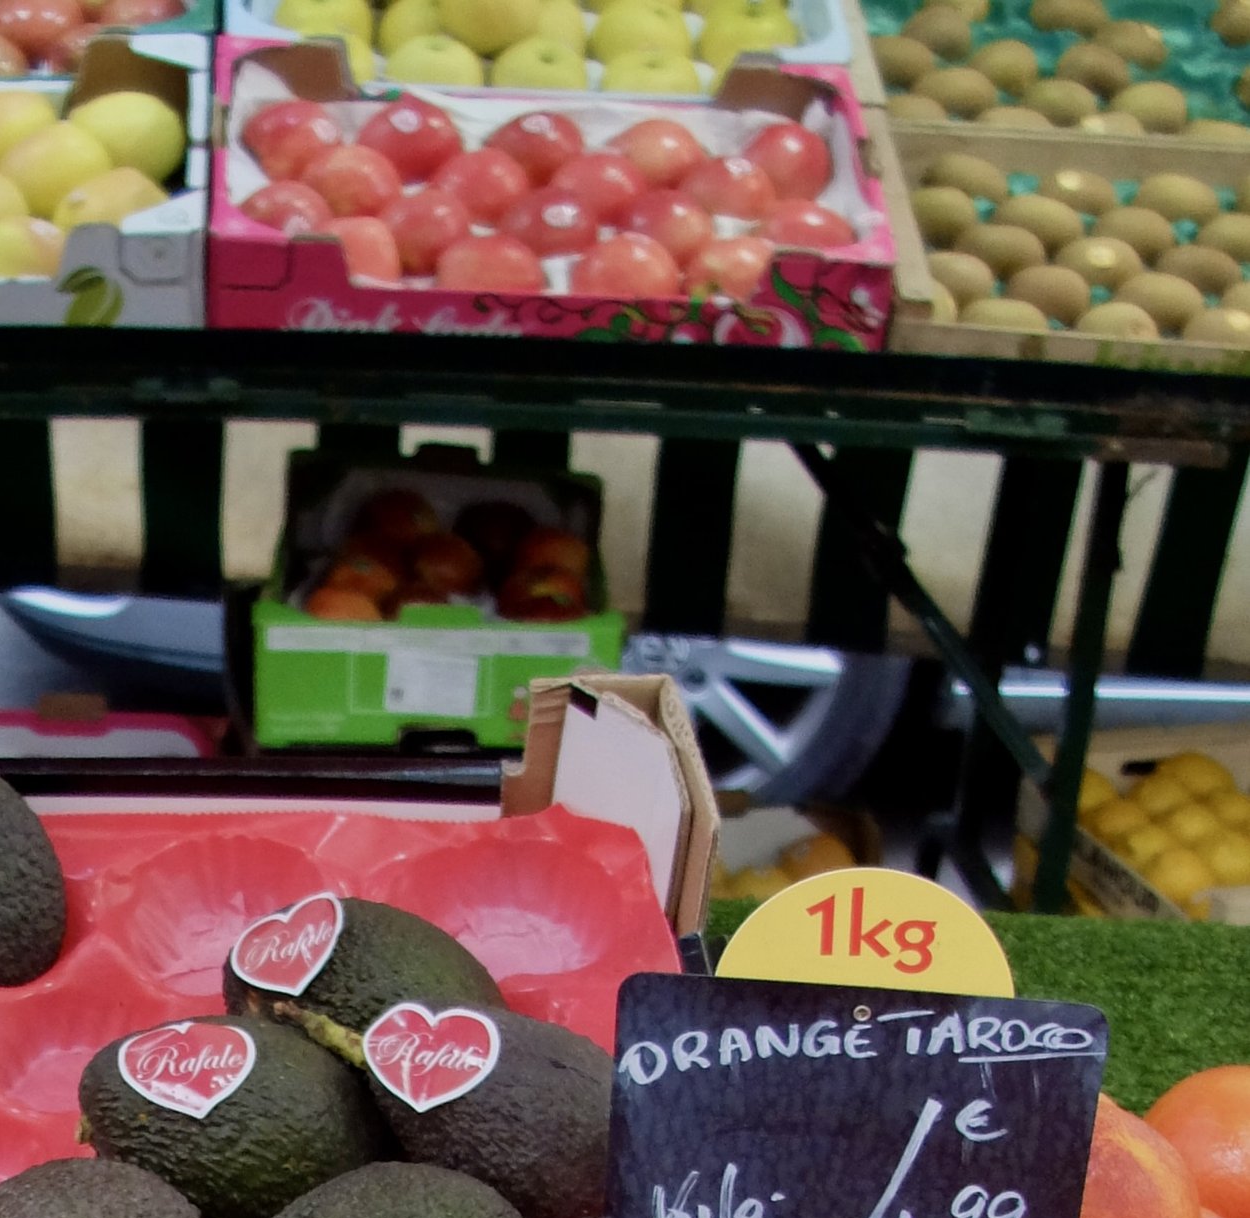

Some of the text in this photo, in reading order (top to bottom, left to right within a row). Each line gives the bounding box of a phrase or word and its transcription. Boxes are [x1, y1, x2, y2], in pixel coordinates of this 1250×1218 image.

[805, 887, 937, 974] 1kg
[136, 1042, 244, 1084] Rafale
[377, 1032, 486, 1076] Rafale
[618, 1018, 878, 1086] ORANGE
